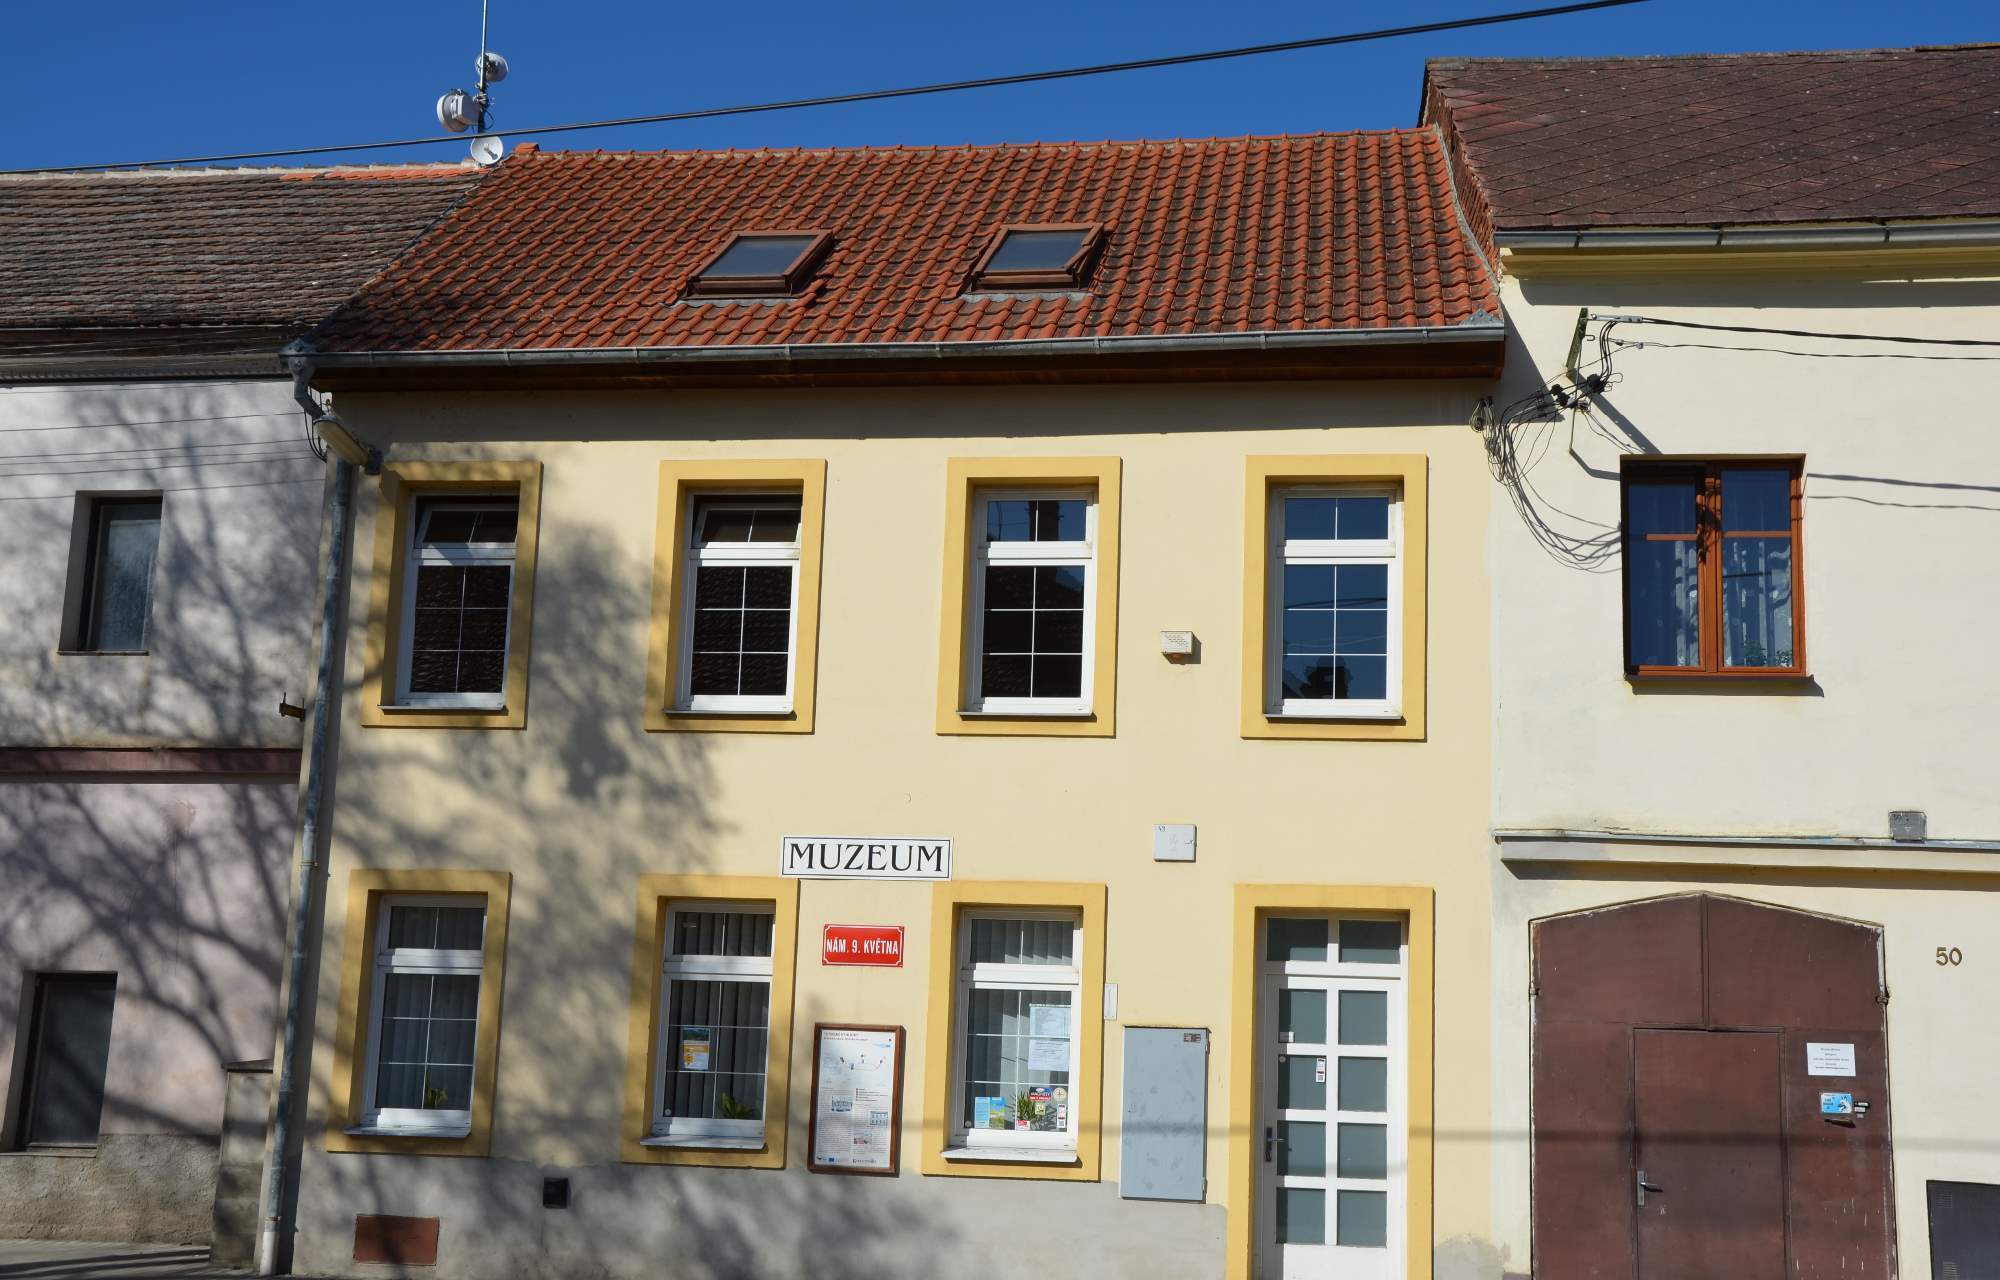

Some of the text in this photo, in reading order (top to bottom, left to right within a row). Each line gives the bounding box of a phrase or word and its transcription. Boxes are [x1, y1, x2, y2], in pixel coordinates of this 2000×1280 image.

[789, 843, 944, 872] MUZEUM
[826, 936, 899, 955] NÁM. 9. KVĚTNA
[1936, 946, 1963, 966] 50
